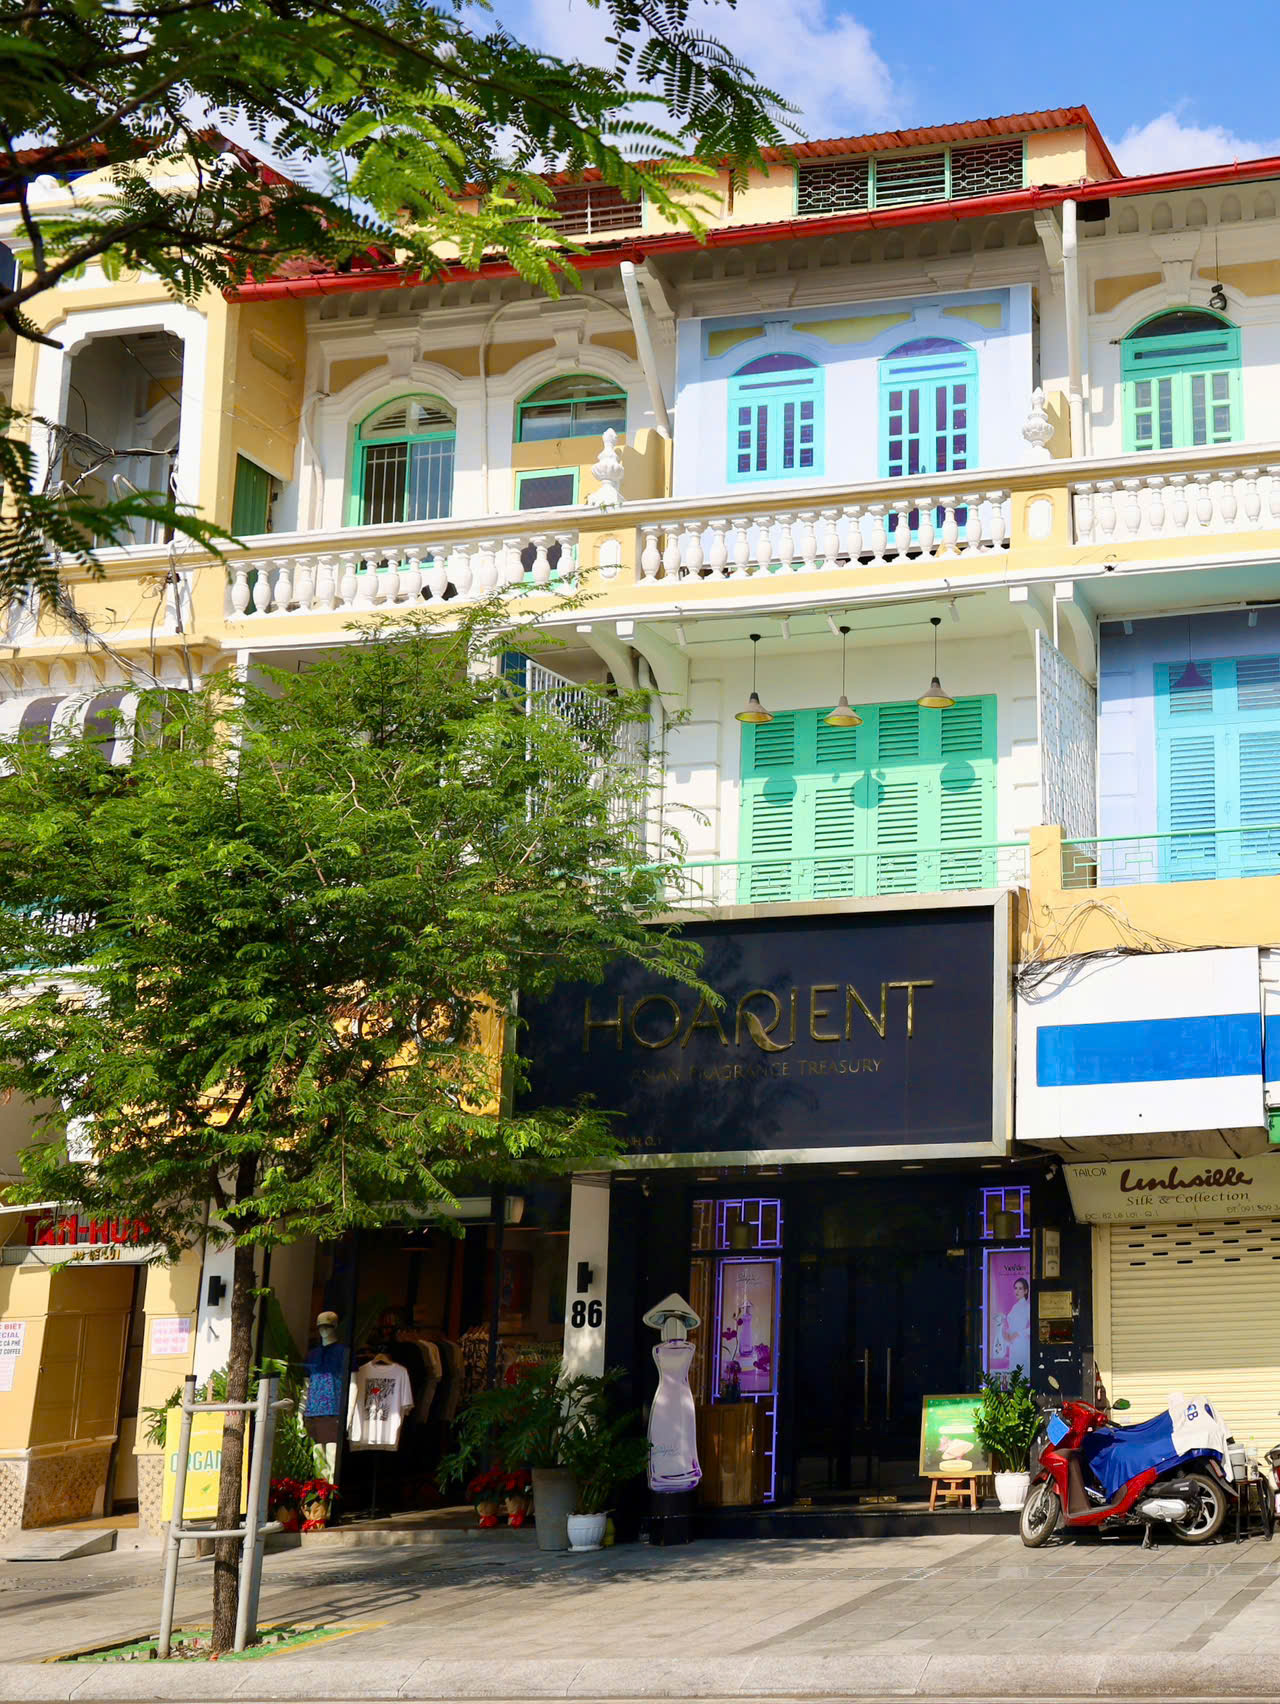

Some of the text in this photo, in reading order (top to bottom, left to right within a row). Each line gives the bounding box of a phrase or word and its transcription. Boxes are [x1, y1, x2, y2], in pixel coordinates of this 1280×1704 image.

[583, 980, 936, 1053] HOARIENT
[799, 1057, 883, 1076] TREASURY
[1072, 1167, 1108, 1177] TAILOR
[1127, 1191, 1249, 1206] Silk & Collection
[571, 1299, 603, 1328] 86
